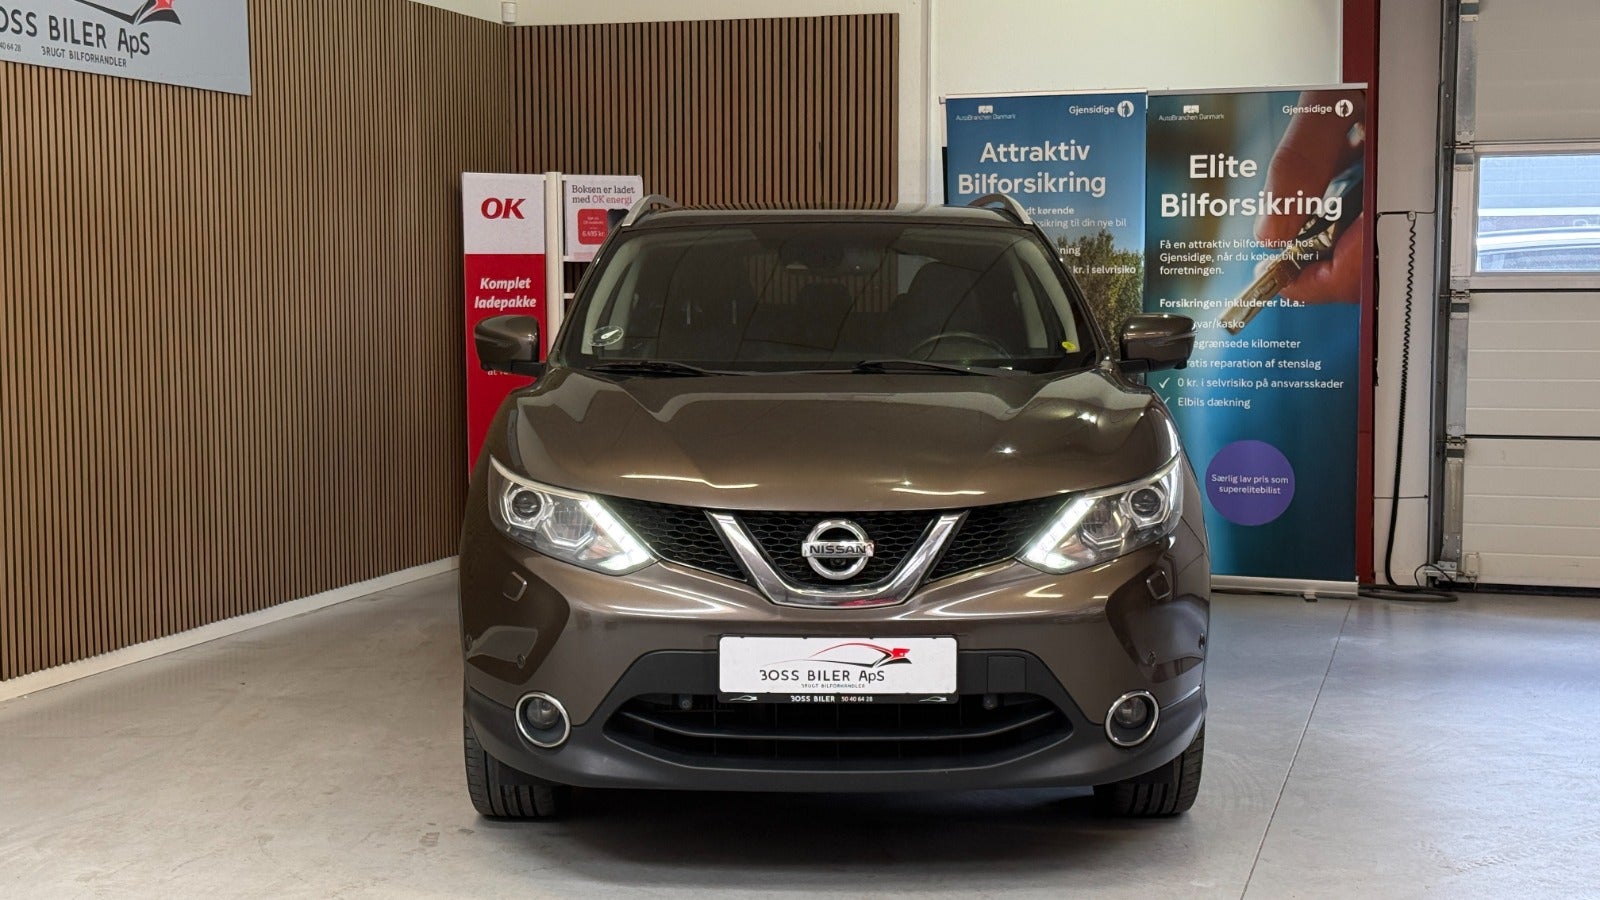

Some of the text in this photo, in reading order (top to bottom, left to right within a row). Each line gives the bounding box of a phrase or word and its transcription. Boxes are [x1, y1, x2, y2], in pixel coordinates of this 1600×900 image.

[0, 6, 151, 59] OSS BILER ApS
[69, 50, 127, 68] BILFORHANDLER
[1068, 105, 1115, 116] Gjensidige
[1282, 104, 1332, 115] Gjensidige
[1158, 114, 1198, 122] AutoBranchen
[980, 140, 1090, 163] Attraktiv
[1190, 153, 1258, 179] Elite
[572, 184, 602, 194] Boksen
[614, 185, 636, 194] ladet
[958, 171, 1106, 198] Bilforsikring
[572, 194, 632, 206] med OK energi
[1161, 190, 1342, 221] Bilforsikring
[481, 198, 526, 220] OK
[1038, 206, 1075, 215] kørende
[1070, 219, 1080, 227] til
[1082, 219, 1096, 227] din
[1097, 220, 1114, 228] nye
[1116, 218, 1127, 227] bil
[1160, 240, 1173, 249] Få
[1188, 240, 1231, 249] attraktiv
[1233, 239, 1293, 250] bilforsikring
[1296, 239, 1314, 248] hos
[1160, 251, 1319, 264] Gjensidige, når du køber bil her i
[1072, 265, 1085, 274] kr.
[1086, 265, 1090, 274] i
[1092, 264, 1136, 274] selvrisiko
[1160, 266, 1224, 276] forretningen.
[480, 276, 531, 292] Komplet
[474, 296, 537, 311] ladepakke
[1160, 298, 1305, 309] Forsikringen inkluderer bl.a.:
[1194, 340, 1301, 350] egrænsede kilometer
[1210, 360, 1262, 370] reparation
[1265, 359, 1276, 368] af
[1278, 359, 1322, 370] stenslag
[1178, 378, 1344, 390] 0 kr. i selvrisiko på ansvarsskader
[1178, 397, 1250, 409] Elbils dækning
[1212, 474, 1238, 484] Særlig
[1240, 474, 1252, 483] lav
[1254, 475, 1270, 485] pris
[1219, 485, 1281, 495] superelitebilist
[810, 545, 866, 554] NISSAN
[808, 670, 850, 681] BILER
[858, 670, 885, 684] ApS
